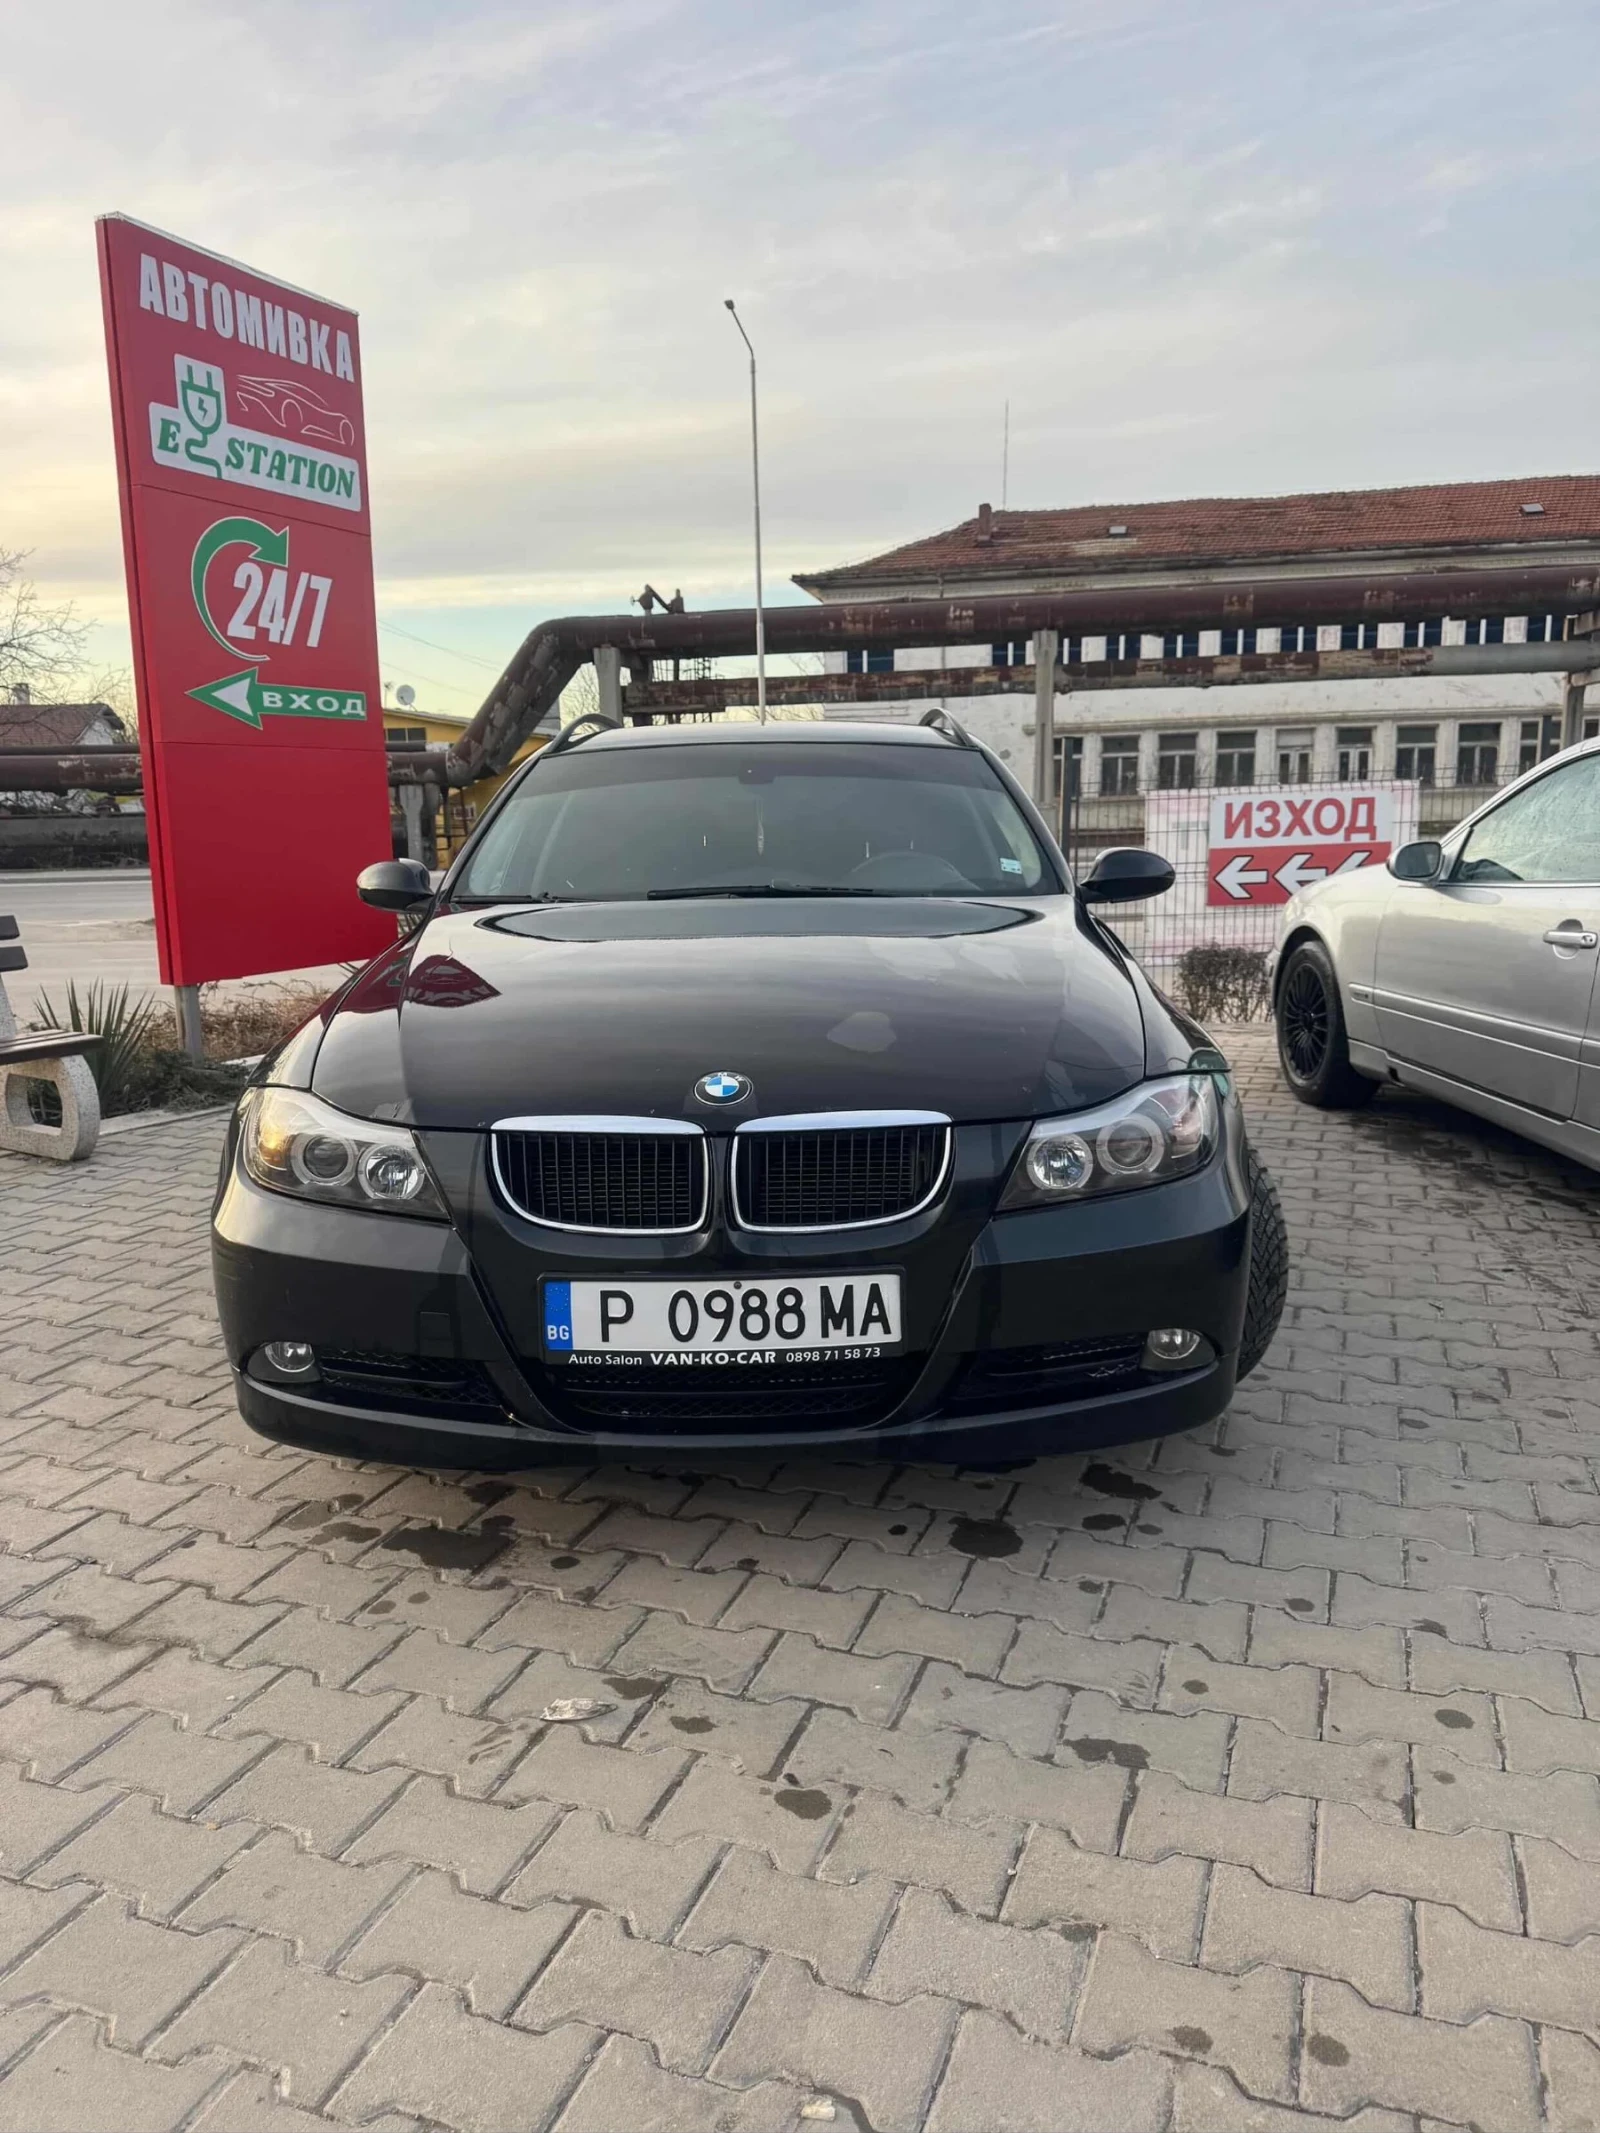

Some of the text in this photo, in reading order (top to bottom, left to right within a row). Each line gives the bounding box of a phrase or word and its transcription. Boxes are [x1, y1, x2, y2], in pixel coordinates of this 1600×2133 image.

[139, 253, 355, 383] АВТОМИВКА
[157, 418, 355, 498] E STATION
[227, 562, 333, 647] 24/7
[262, 691, 366, 716] ВХОД
[1224, 797, 1377, 841] ИЗХОД
[547, 1325, 570, 1341] BG
[600, 1283, 892, 1342] P 0988 MA
[569, 1347, 881, 1366] Auto Salon VAN-KO-CAR 0898 71 58 73
